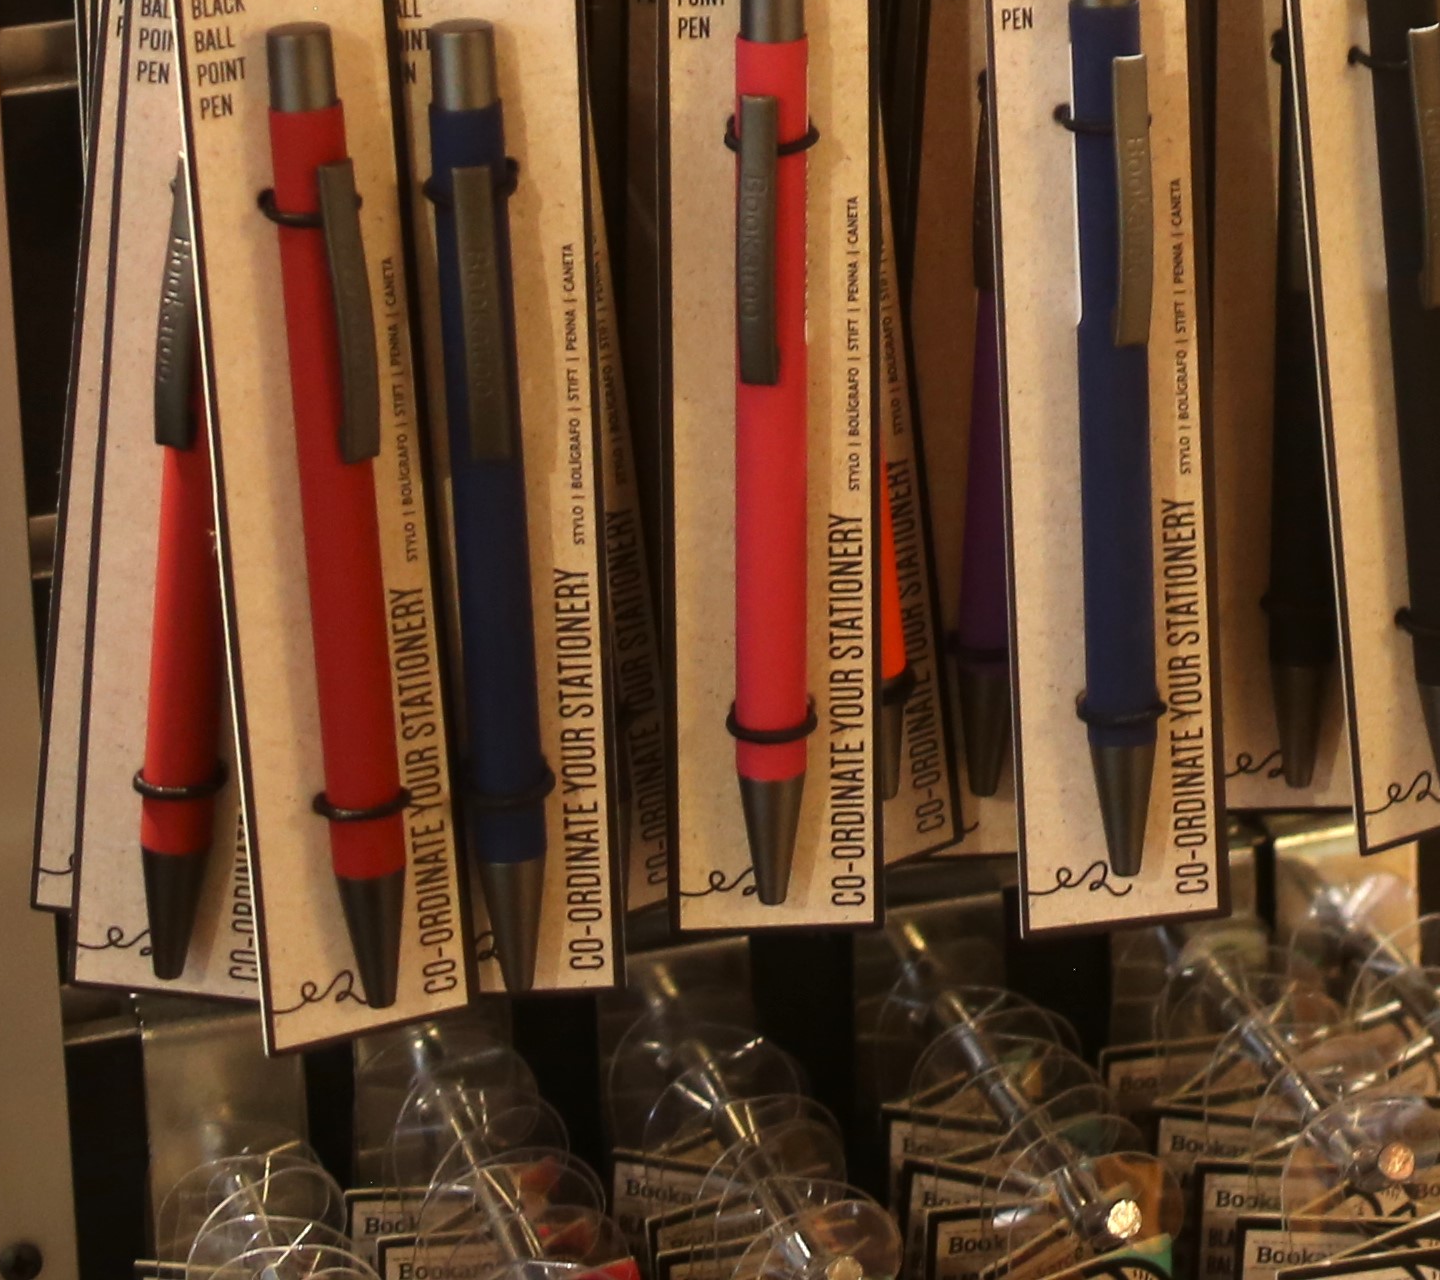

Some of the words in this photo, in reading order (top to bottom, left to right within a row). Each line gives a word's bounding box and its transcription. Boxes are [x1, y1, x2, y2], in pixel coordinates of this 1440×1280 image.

[194, 28, 236, 54] BALL
[677, 16, 711, 40] PEN
[1000, 7, 1034, 32] PEN
[136, 60, 170, 85] PEN
[196, 56, 247, 87] POINT
[199, 93, 233, 121] PEN
[846, 195, 859, 245] CANETA
[1170, 177, 1182, 227] CANETA
[381, 256, 395, 308] CANETA
[562, 243, 574, 291] CANETA
[847, 260, 859, 304] PENNA
[1173, 242, 1185, 285] PENNA
[564, 310, 576, 352] PENNA
[847, 319, 859, 352] STIFT
[1175, 300, 1186, 334] STIFT
[387, 323, 400, 376] PENNA
[392, 382, 407, 418] STIFT
[567, 368, 579, 401] STIFT
[848, 451, 860, 492] STYLO
[1179, 435, 1192, 475] STYLO
[406, 520, 417, 563] STYLO
[573, 506, 585, 546] STYLO
[828, 512, 865, 670] STATIONERY
[1162, 498, 1202, 651] STATIONERY
[388, 585, 438, 742] STATIONERY
[556, 567, 593, 721] STATIONERY
[829, 670, 865, 742] YOUR
[1167, 651, 1203, 730] YOUR
[405, 742, 444, 823] YOUR
[561, 723, 596, 801] YOUR
[830, 740, 867, 908] CO-ORDINATE
[1171, 730, 1210, 897] CO-ORDINATE
[408, 820, 457, 996] CO-ORDINATE
[565, 800, 604, 972] CO-ORDINATE
